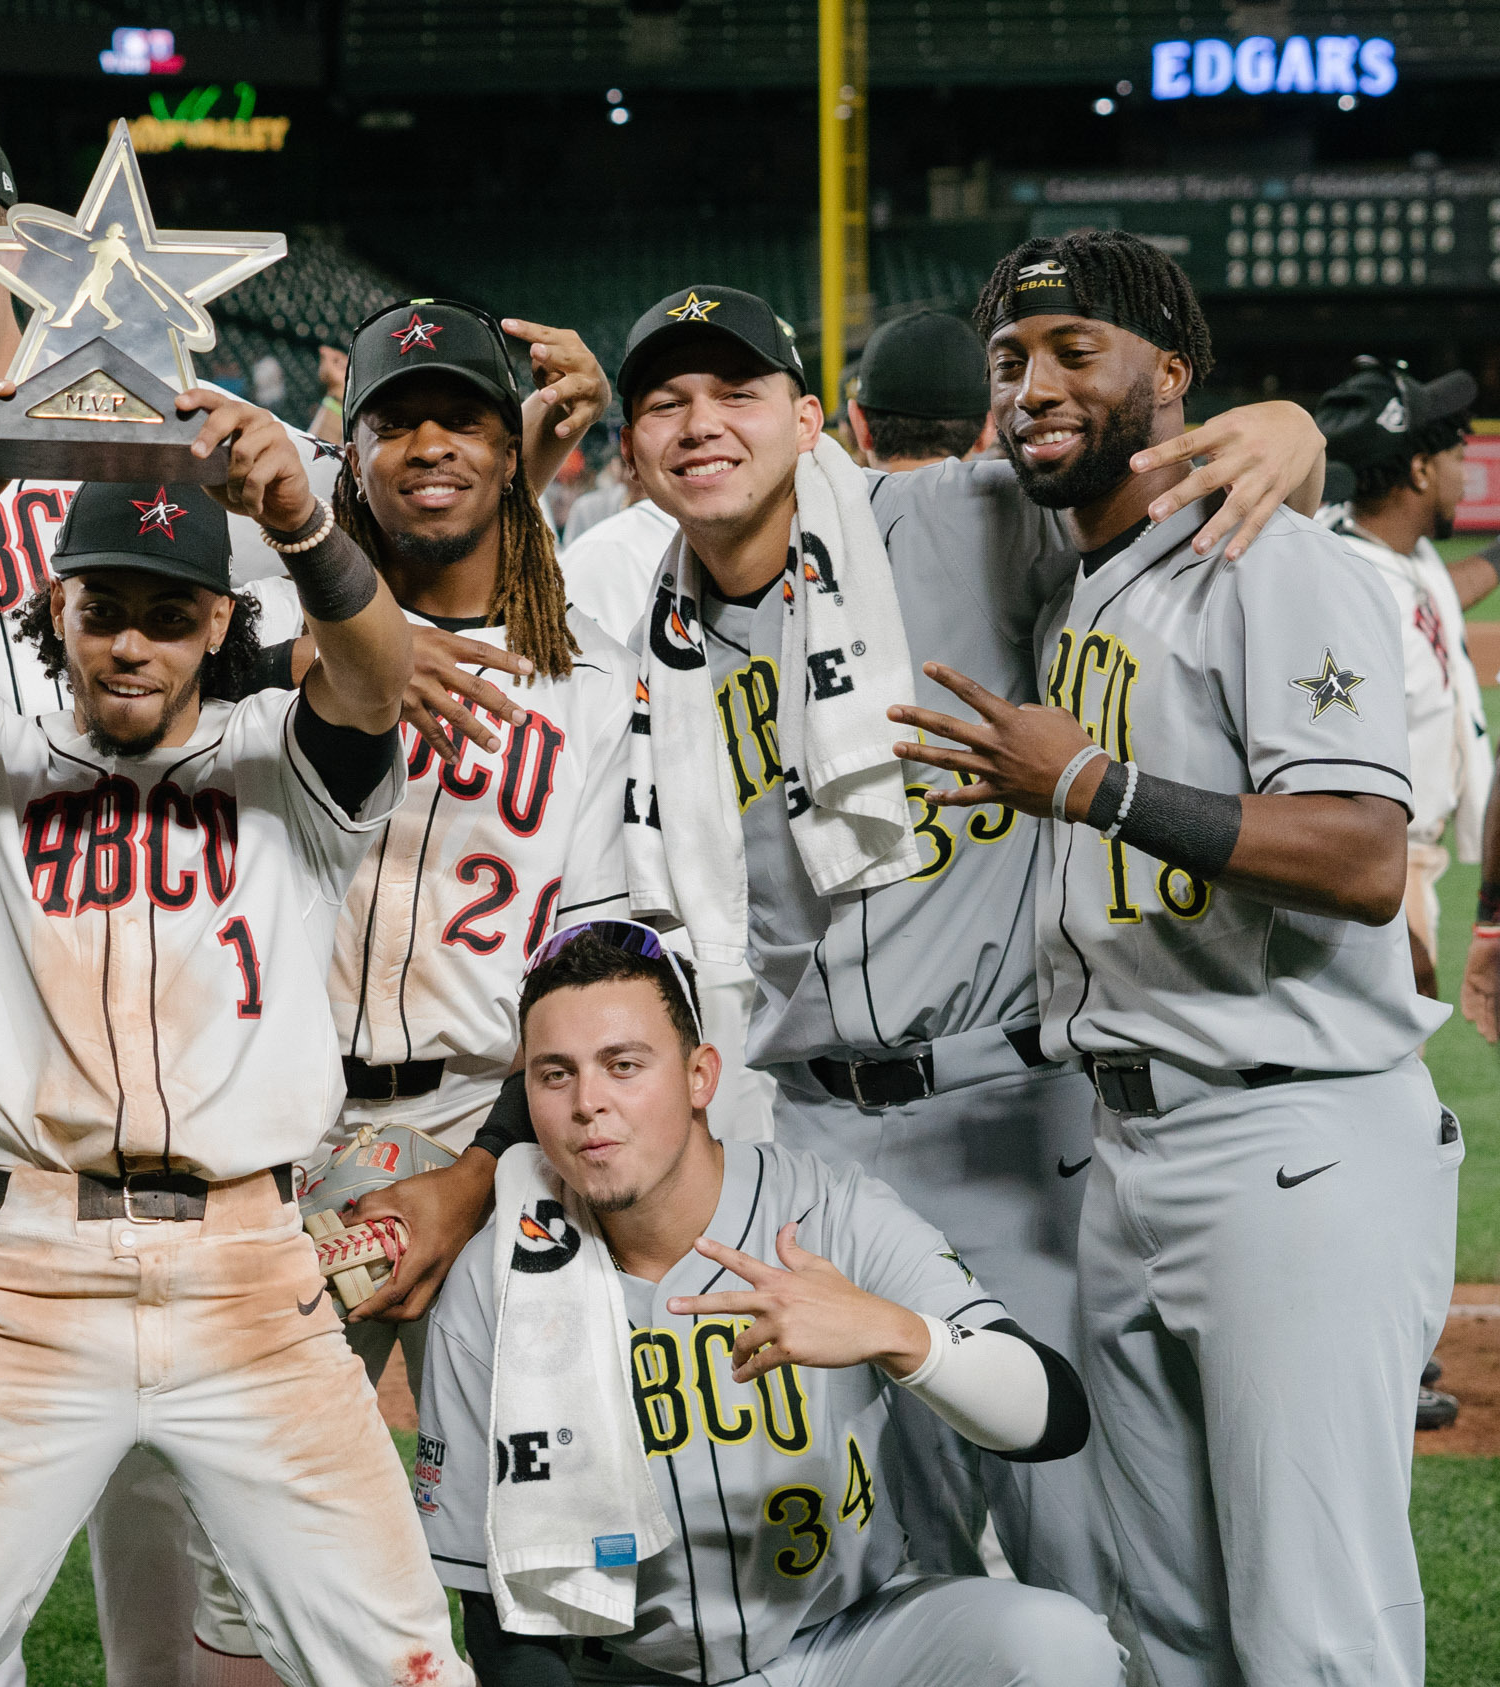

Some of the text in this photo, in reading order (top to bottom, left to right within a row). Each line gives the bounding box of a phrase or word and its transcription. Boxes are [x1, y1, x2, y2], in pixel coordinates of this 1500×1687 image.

[22, 774, 239, 918] HBCU
[216, 916, 263, 1019] 1
[763, 1431, 875, 1579] 34
